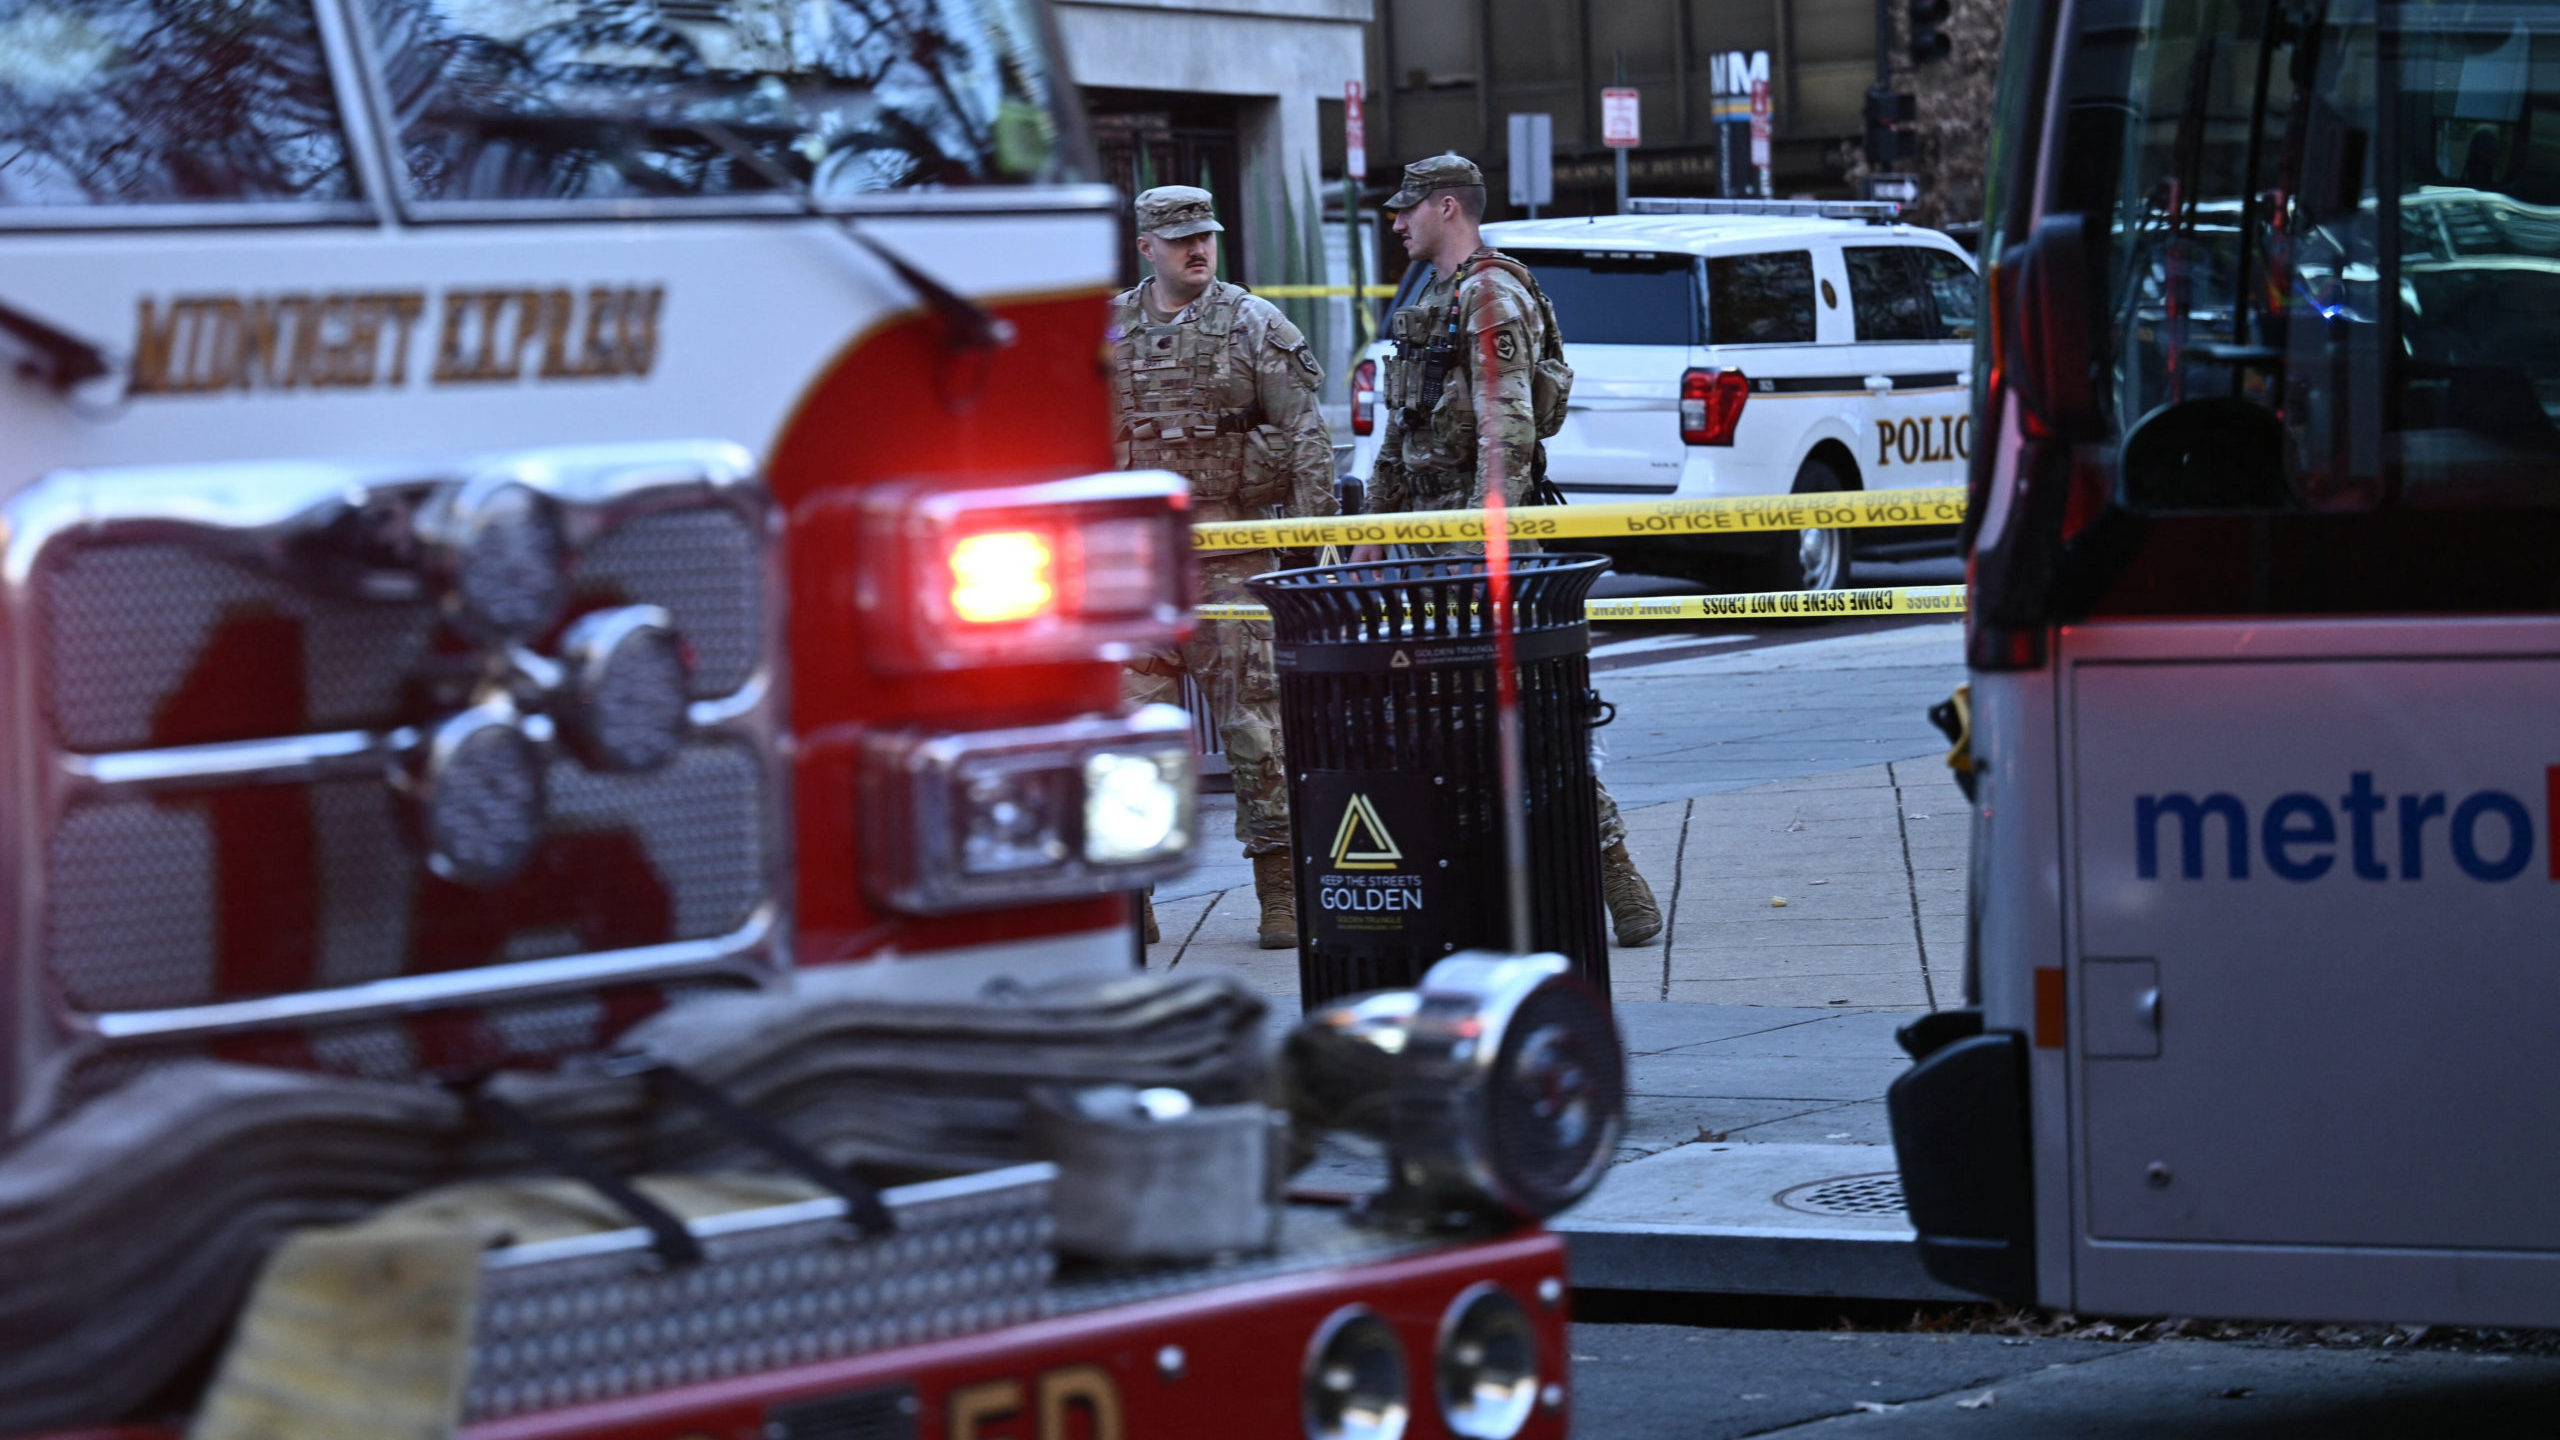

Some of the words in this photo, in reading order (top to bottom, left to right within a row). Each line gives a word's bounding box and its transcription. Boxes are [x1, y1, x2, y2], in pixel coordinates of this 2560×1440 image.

[1728, 50, 1769, 94] M
[128, 294, 424, 398] MIDNIGHT
[431, 286, 664, 386] EXPRESS
[1876, 413, 1970, 467] POLIC
[1702, 595, 1746, 615] CROSS
[1751, 594, 1777, 614] NOT
[1779, 593, 1799, 613] DO
[1803, 591, 1846, 613] SCENE
[1850, 589, 1893, 611] CRIME
[2134, 765, 2560, 883] metro
[1320, 875, 1344, 886] KEEP
[1345, 875, 1367, 887] THE
[1368, 875, 1423, 887] STREETS
[1320, 887, 1423, 911] GOLDEN
